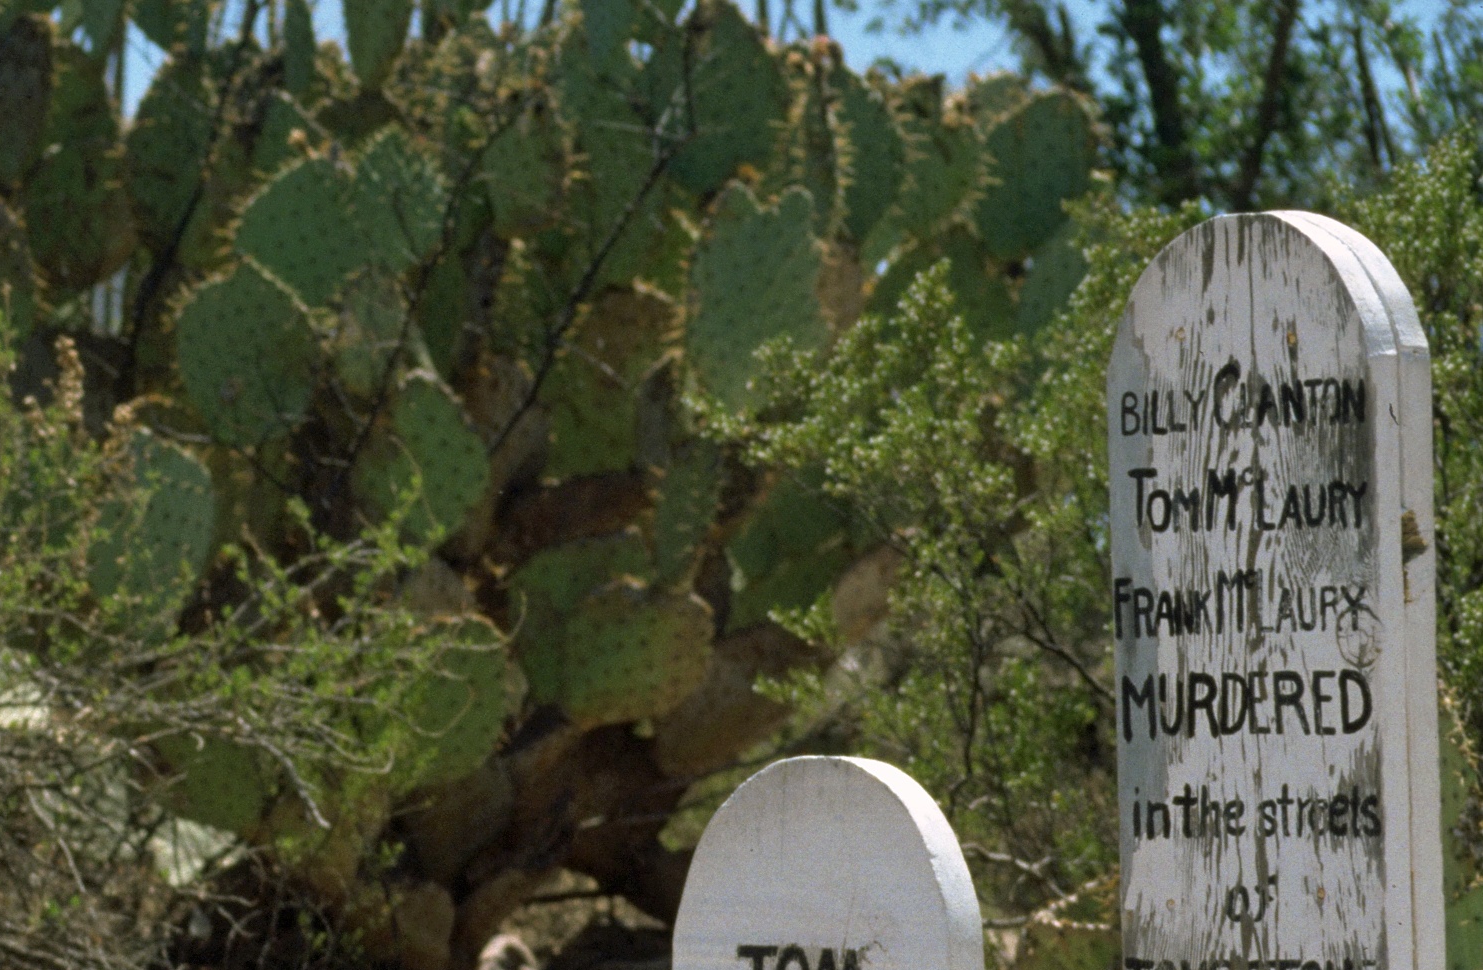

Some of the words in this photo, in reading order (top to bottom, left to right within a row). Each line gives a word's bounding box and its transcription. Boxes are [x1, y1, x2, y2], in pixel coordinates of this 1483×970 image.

[1121, 390, 1204, 437] BILLY
[1214, 361, 1366, 428] CLANTON
[1115, 577, 1211, 639] FRANK
[1121, 669, 1372, 743] MURDERED
[1132, 786, 1171, 839] in
[1173, 784, 1246, 838] the
[1257, 784, 1382, 838] streets
[1226, 873, 1278, 922] of
